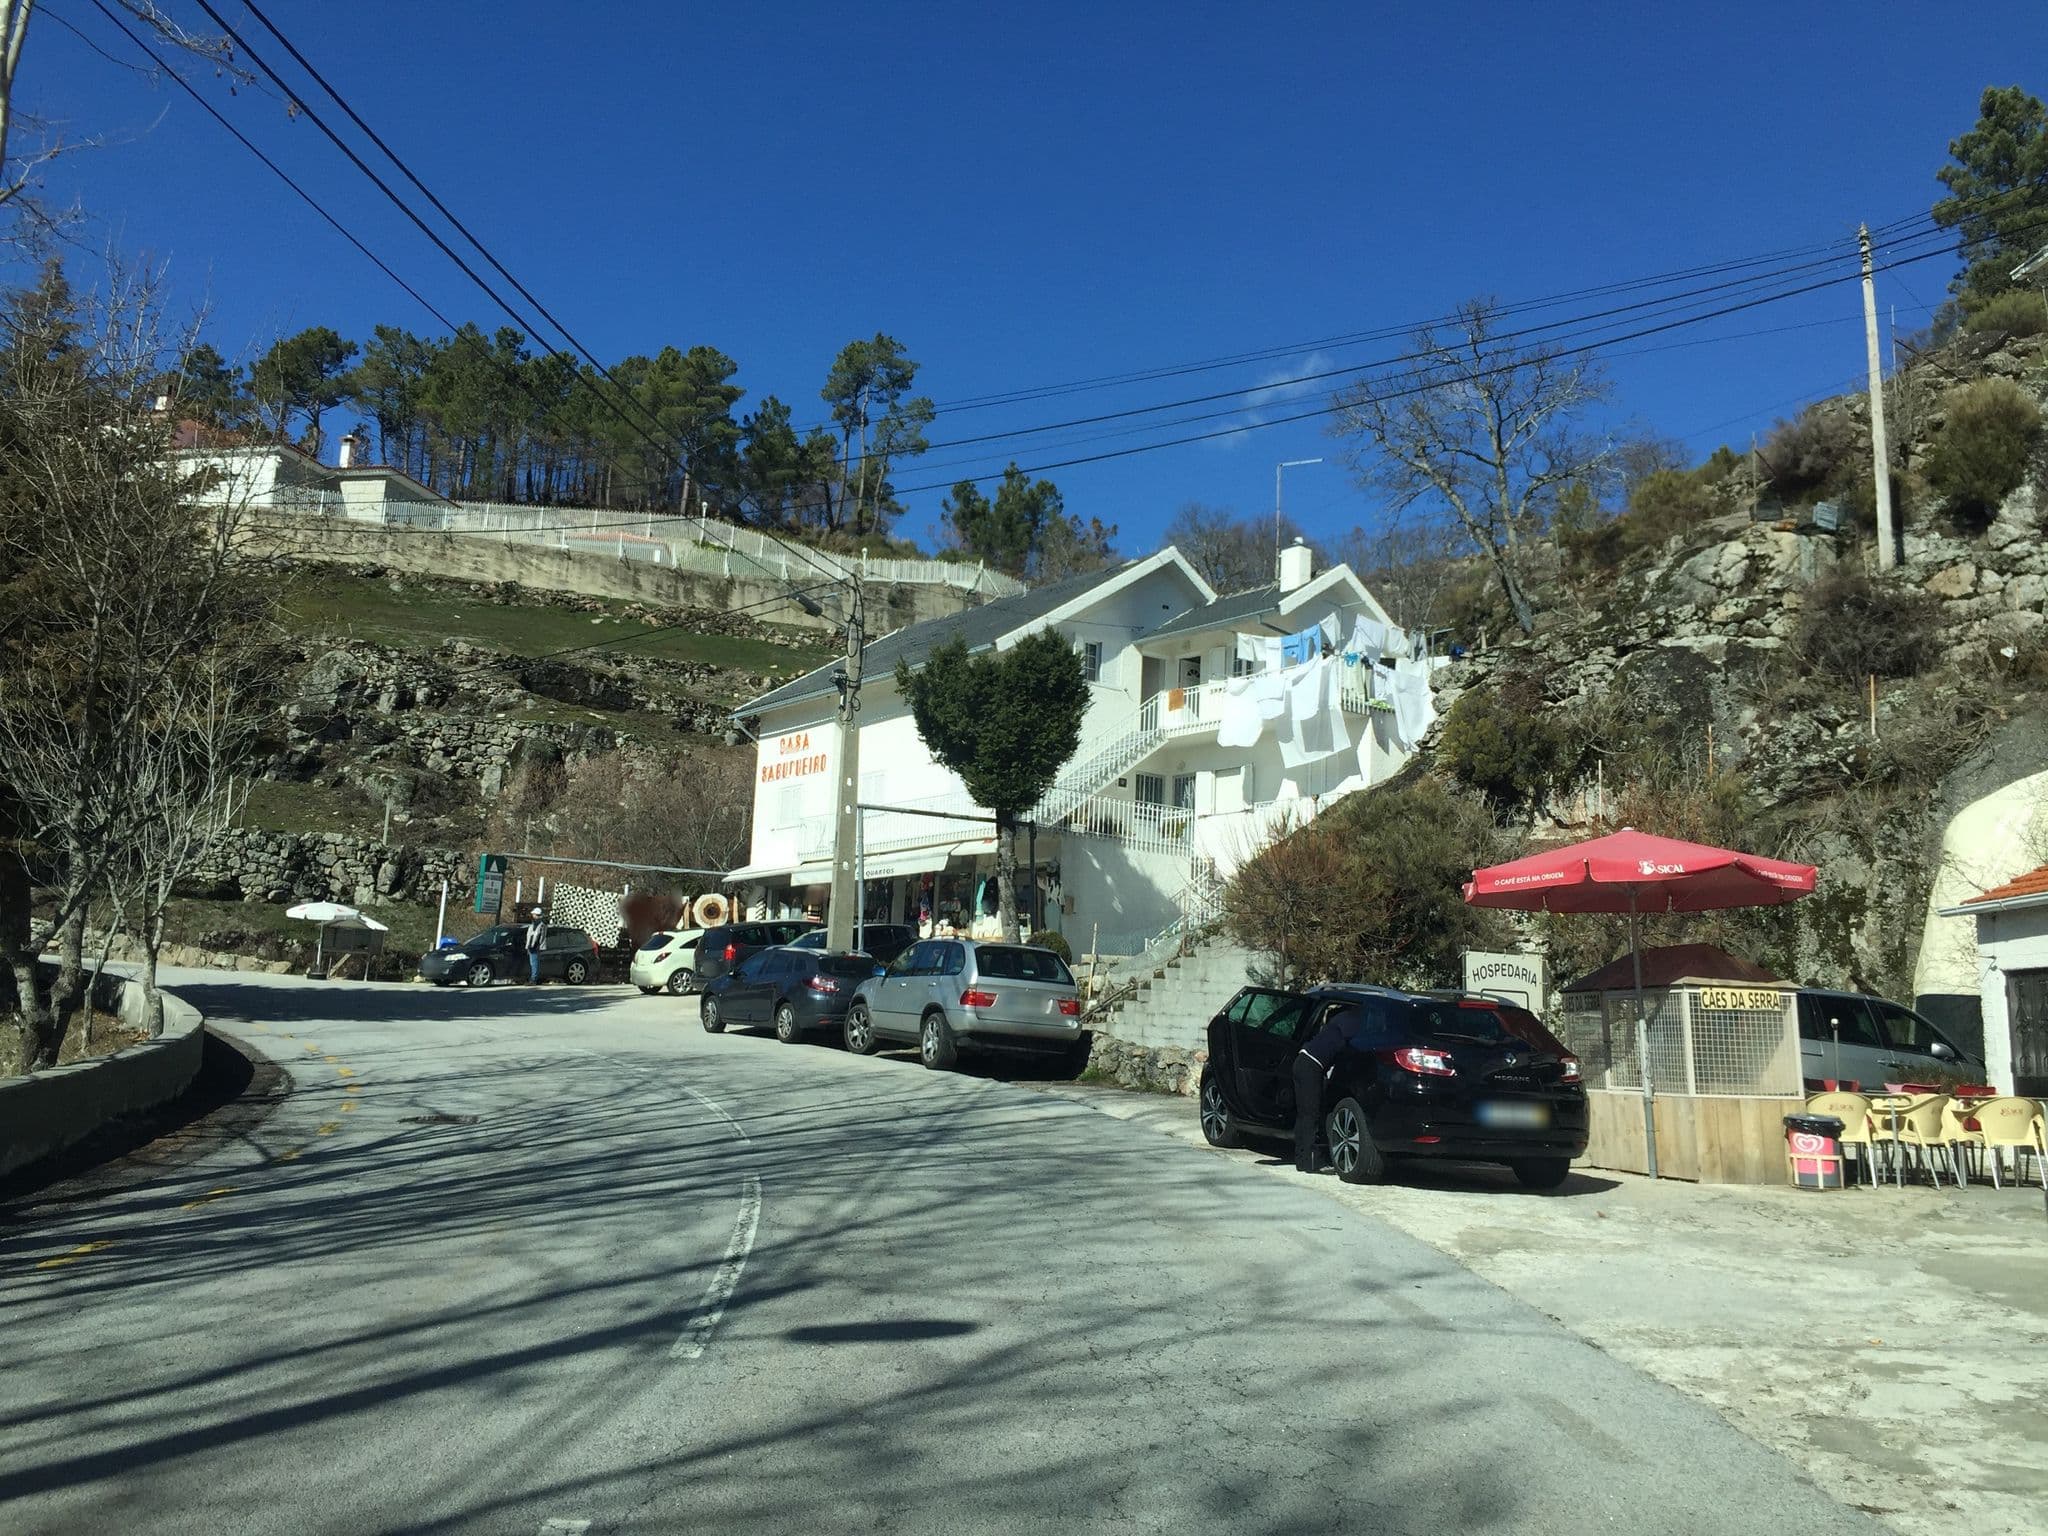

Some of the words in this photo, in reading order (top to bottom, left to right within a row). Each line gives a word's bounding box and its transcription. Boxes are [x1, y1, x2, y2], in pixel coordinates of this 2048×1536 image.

[780, 732, 809, 755] CASA
[866, 869, 895, 877] QUARTOS
[1656, 864, 1685, 873] SICAL
[1500, 877, 1515, 885] CAFÉ
[1472, 963, 1537, 987] HOSPEDARIA
[1730, 992, 1746, 1009] DA
[1748, 992, 1779, 1009] SERRA
